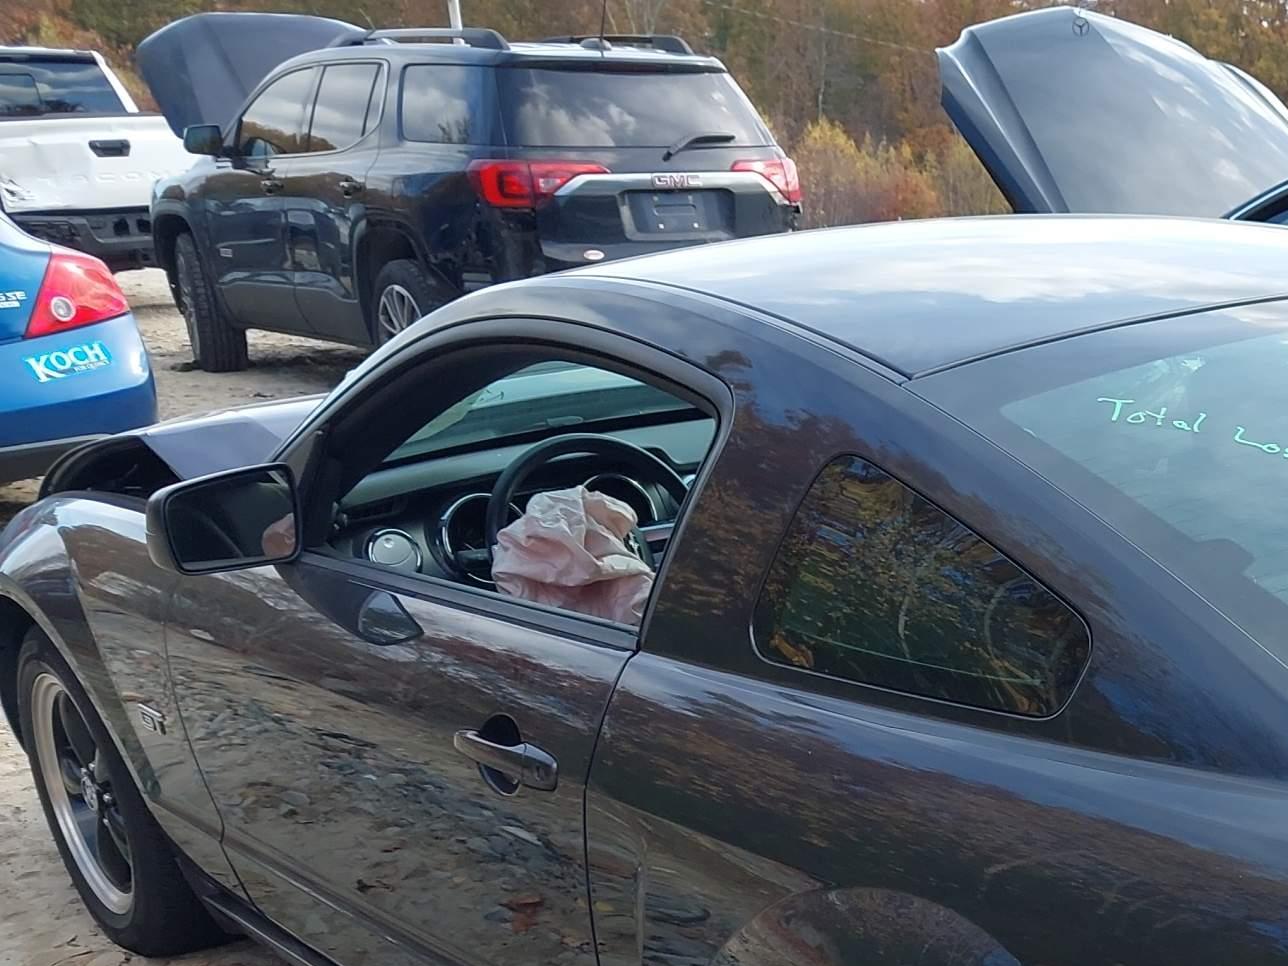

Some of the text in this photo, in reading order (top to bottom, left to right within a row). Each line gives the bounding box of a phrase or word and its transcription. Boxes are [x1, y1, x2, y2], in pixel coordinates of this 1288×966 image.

[652, 174, 703, 187] GMC
[24, 342, 107, 383] KOCH
[1097, 397, 1207, 433] Total
